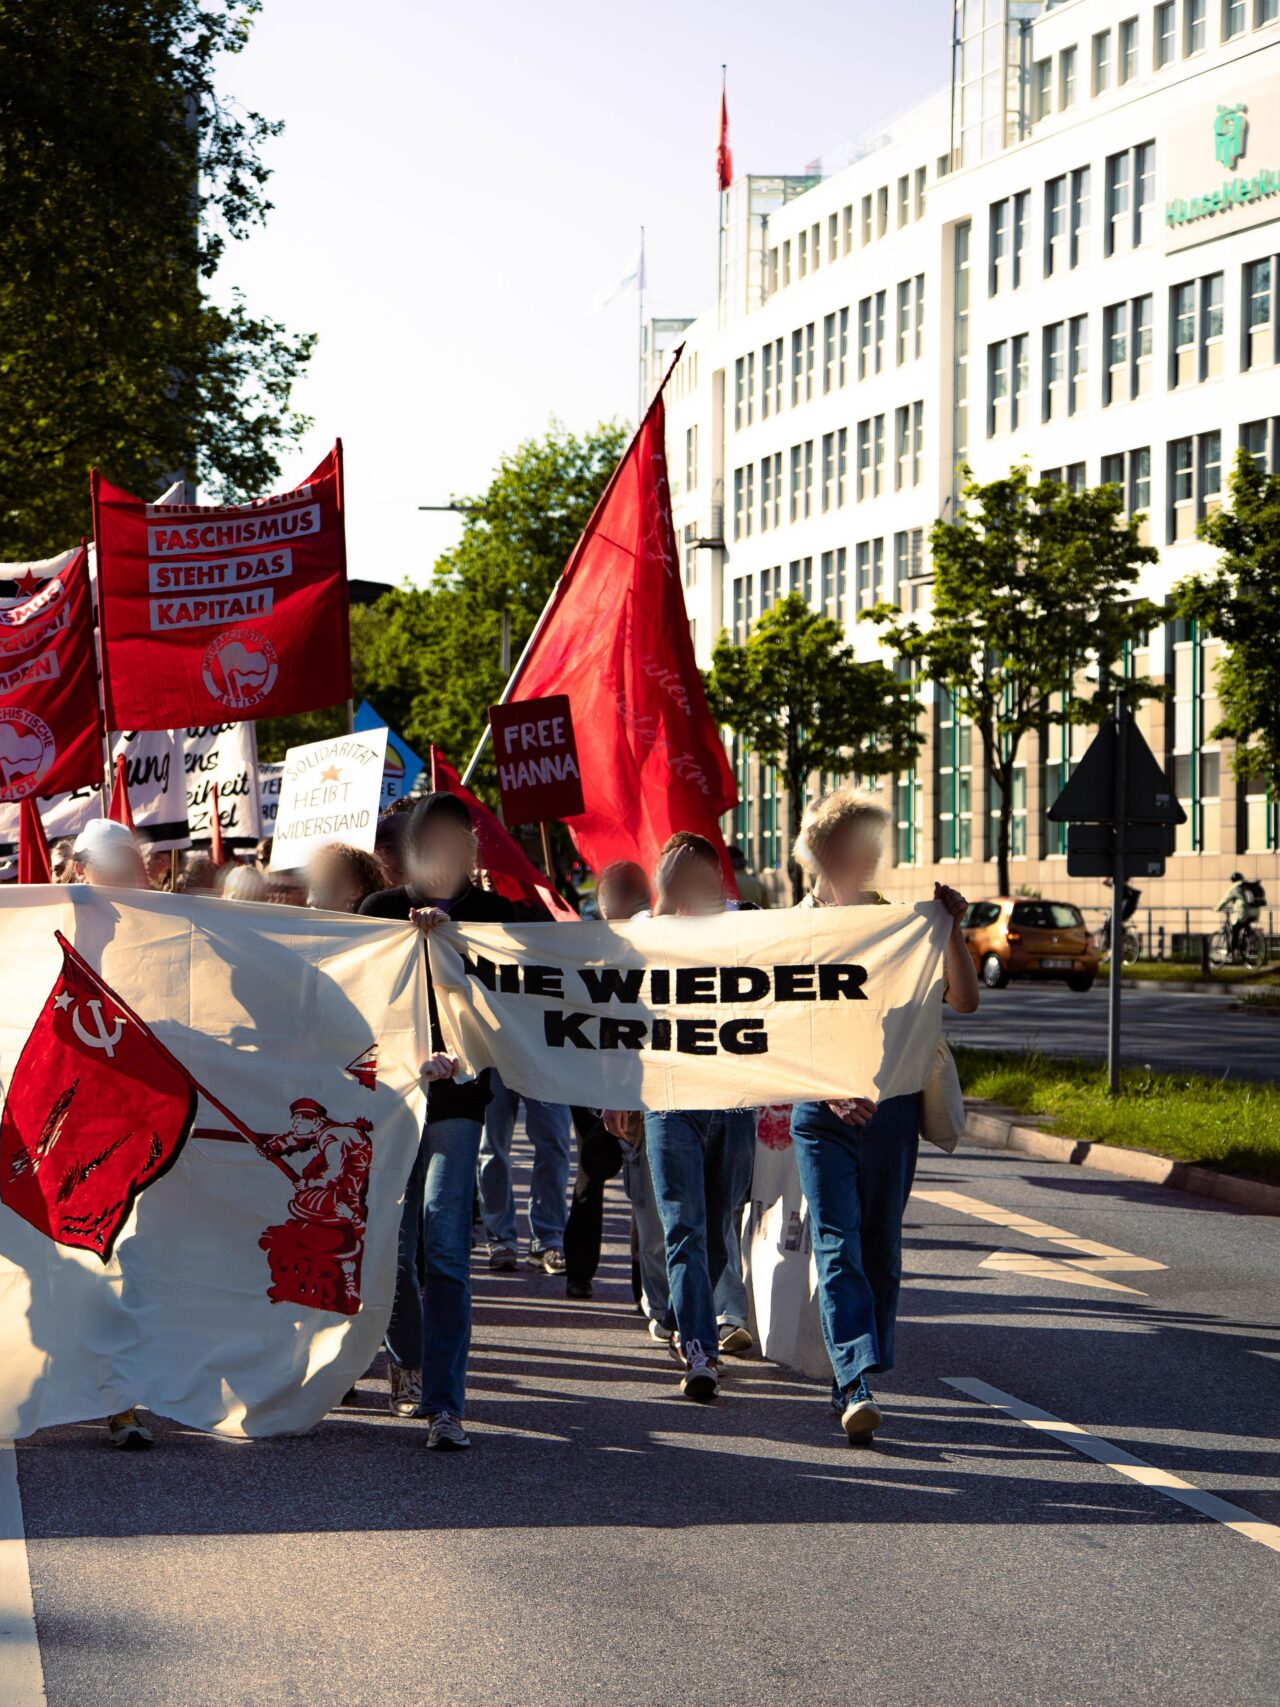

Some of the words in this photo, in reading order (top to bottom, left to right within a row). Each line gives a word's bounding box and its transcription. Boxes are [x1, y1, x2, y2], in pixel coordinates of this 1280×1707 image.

[154, 511, 314, 551] FASCHISMUS
[157, 564, 229, 588] STEHT
[236, 555, 285, 581] DAS
[157, 595, 265, 625] KAPITAL!
[504, 716, 565, 754] FREE
[499, 754, 579, 791] HANNA
[189, 803, 239, 832] Zel
[277, 810, 369, 841] WIDERSTAND
[464, 953, 565, 999] NIE
[578, 964, 869, 1004] WIEDER
[544, 1010, 769, 1055] KRIEG
